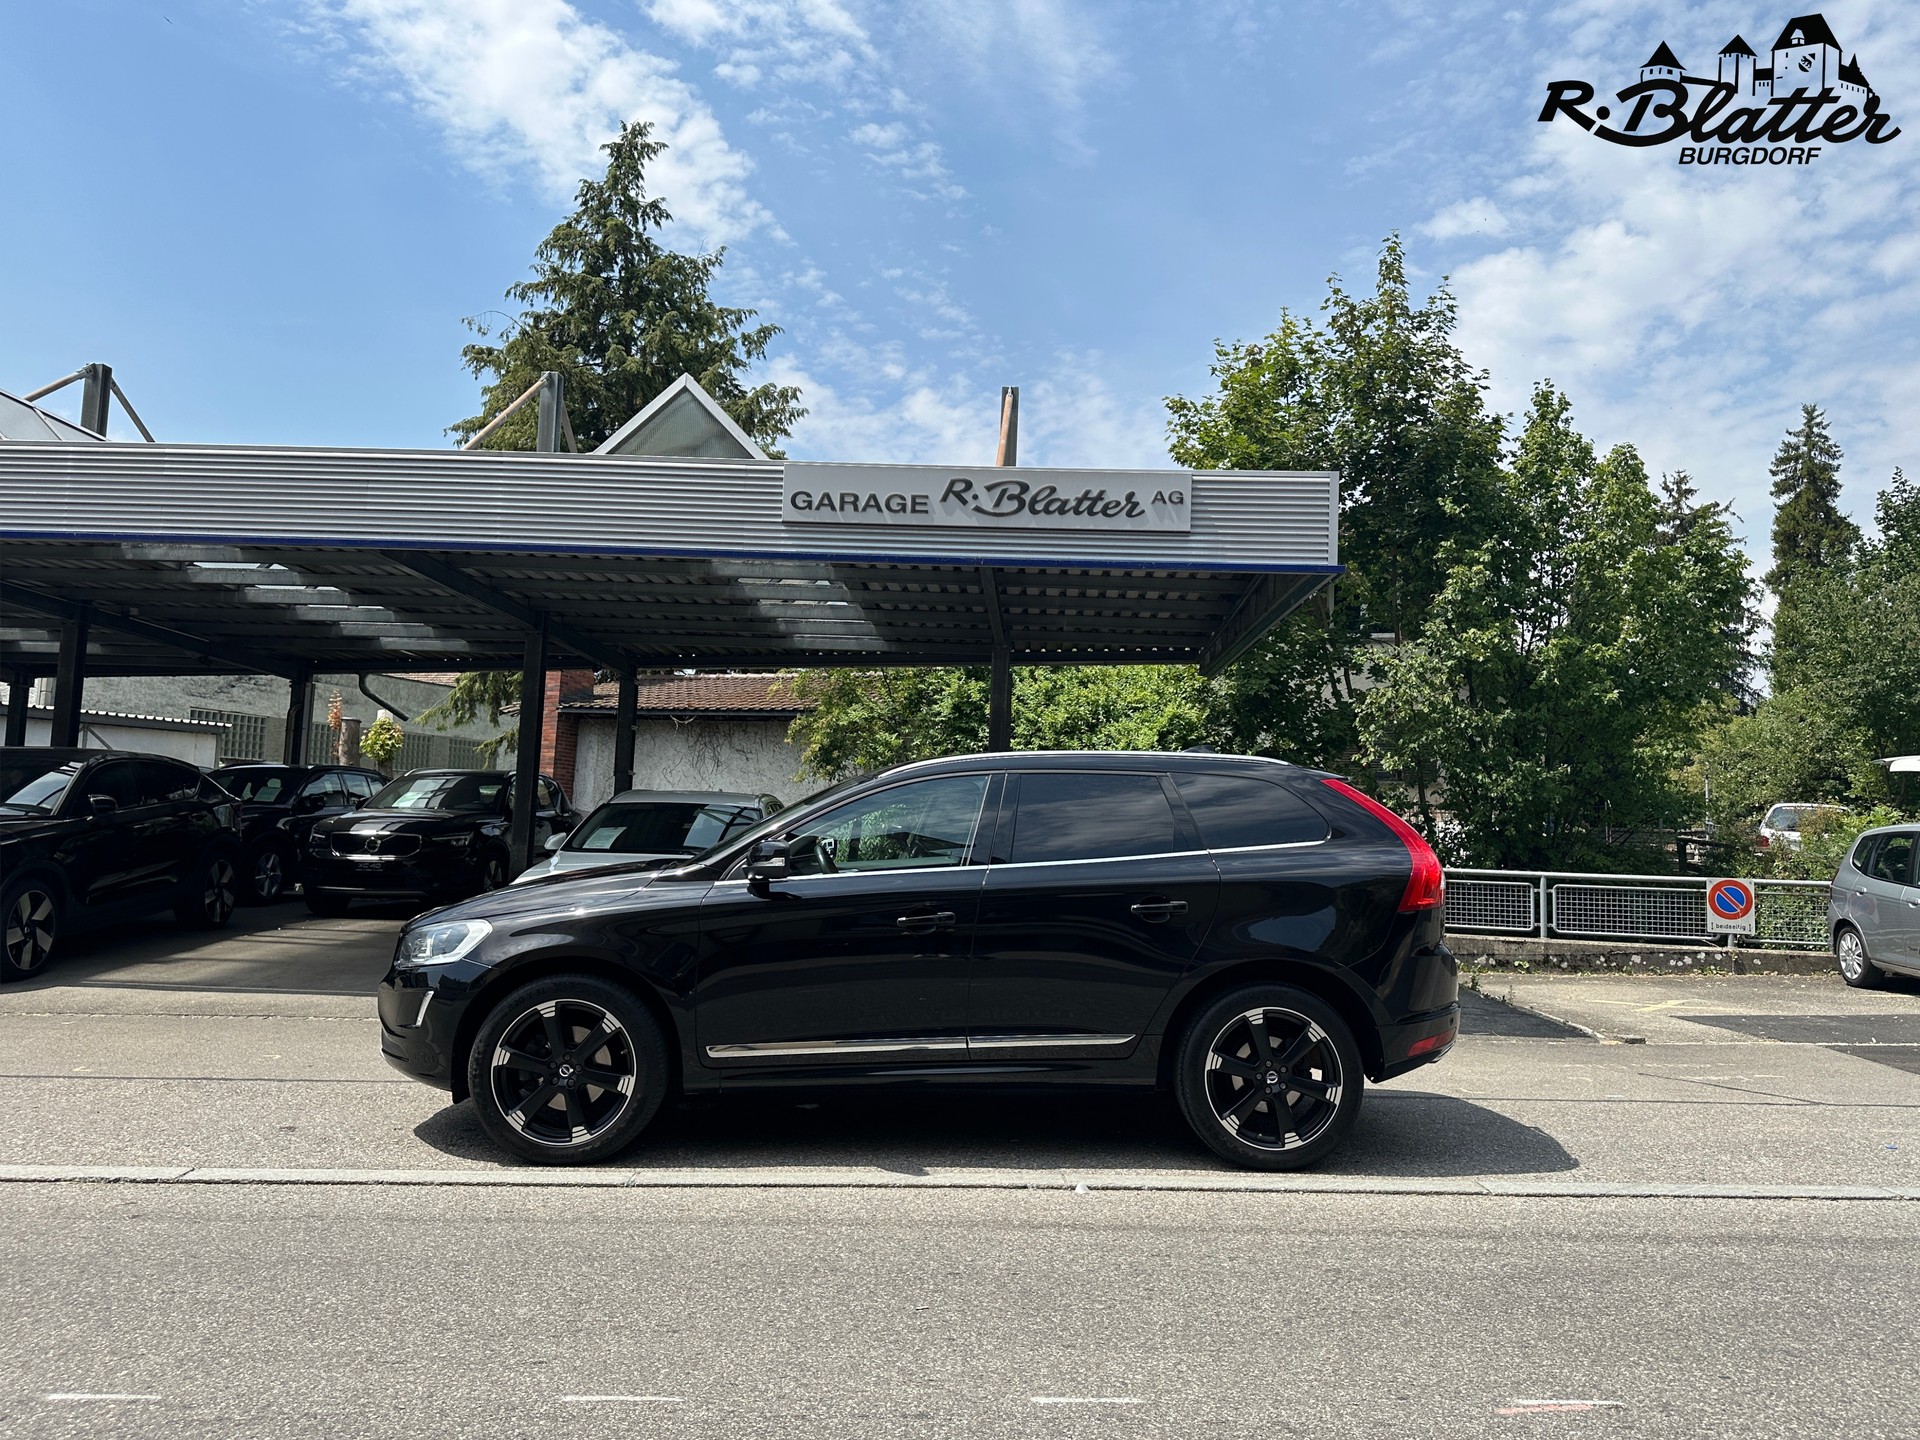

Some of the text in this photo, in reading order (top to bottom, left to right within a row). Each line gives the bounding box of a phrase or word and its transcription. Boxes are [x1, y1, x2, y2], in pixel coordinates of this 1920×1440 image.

[790, 490, 929, 514] GARAGE
[1151, 489, 1184, 505] AG
[1715, 923, 1746, 931] beidseitig
